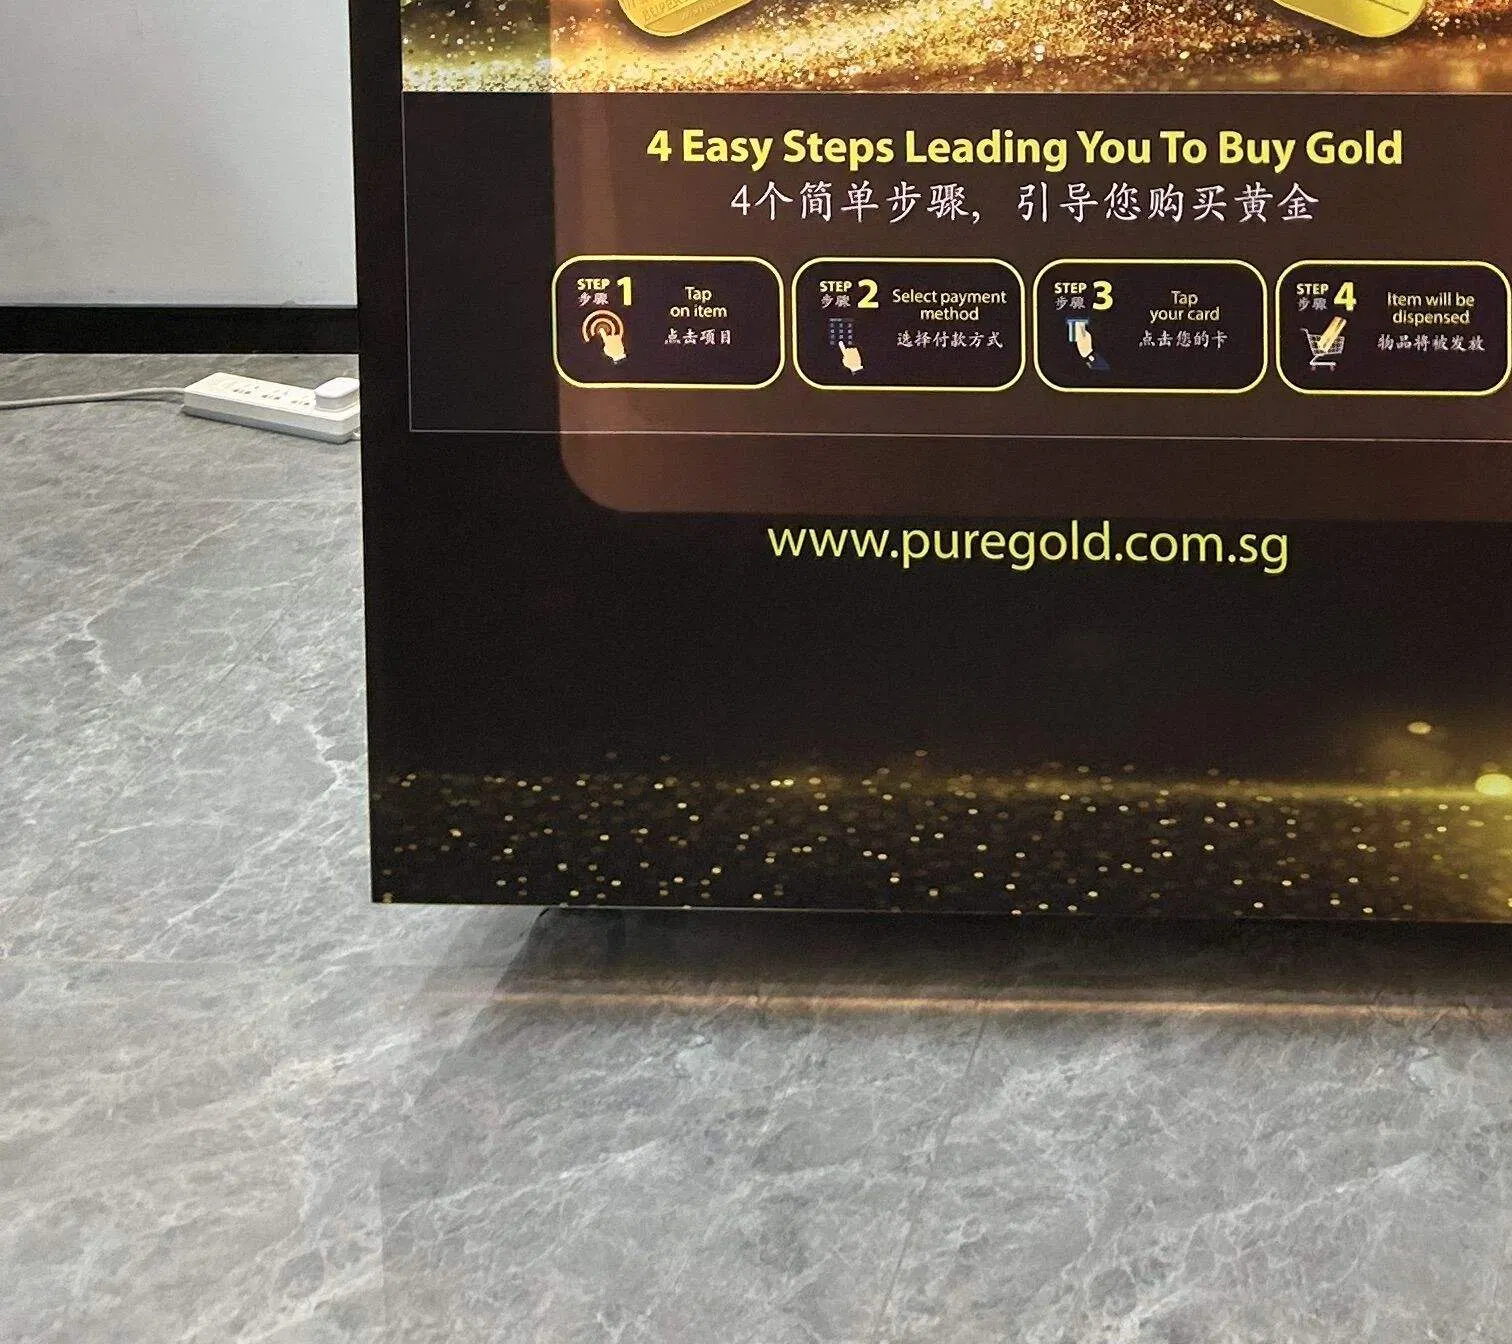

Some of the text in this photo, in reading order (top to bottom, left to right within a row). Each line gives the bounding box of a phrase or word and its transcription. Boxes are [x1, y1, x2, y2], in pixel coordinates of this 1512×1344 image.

[646, 129, 1403, 174] 4 Easy Steps Leading You To Buy Gold
[577, 276, 632, 306] STEP 1
[578, 292, 610, 307] 步骤
[684, 285, 713, 304] Tap
[819, 278, 880, 309] STEP 2
[892, 289, 1007, 310] Select payment
[1054, 280, 1114, 311] STEP 3
[1170, 290, 1199, 309] Tap
[1296, 281, 1357, 312] STEP 4
[1387, 291, 1475, 307] Item will be
[670, 304, 727, 318] on item
[820, 294, 852, 309] 步骤
[1055, 295, 1087, 311] 步骤
[1298, 297, 1328, 312] 步骤
[920, 307, 979, 321] method
[1149, 306, 1220, 324] your card
[1392, 310, 1471, 327] dispensed
[664, 327, 732, 346] 点击项目
[896, 330, 1004, 349] 选择付款方式
[1138, 330, 1228, 350] 点击您的卡
[767, 519, 1290, 575] www.puregold.com.sg
